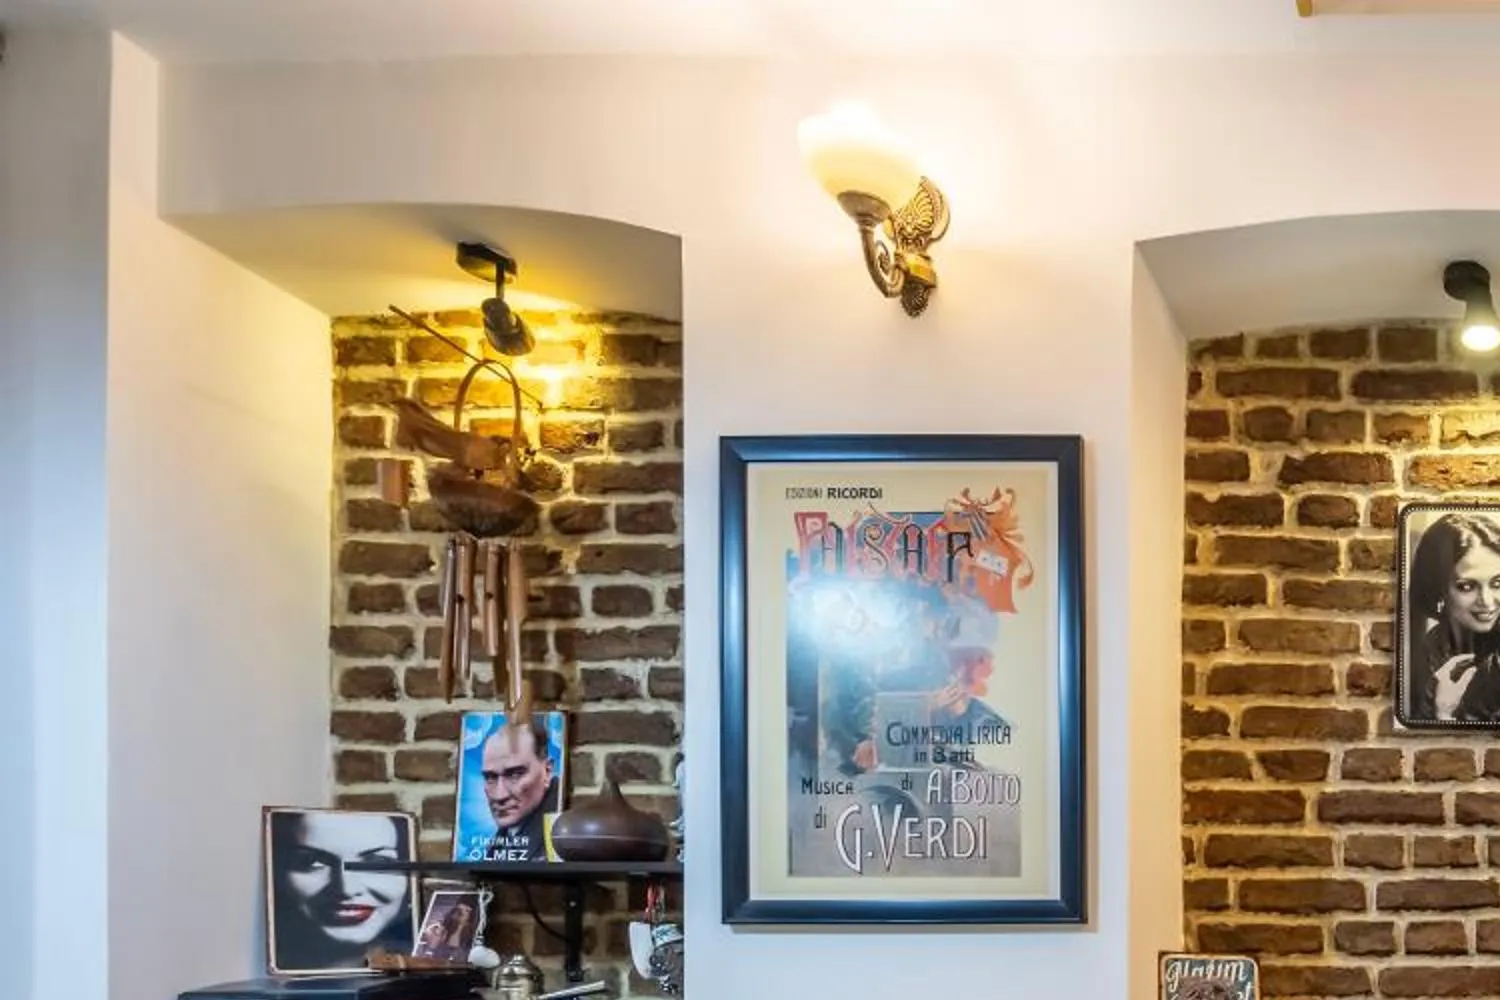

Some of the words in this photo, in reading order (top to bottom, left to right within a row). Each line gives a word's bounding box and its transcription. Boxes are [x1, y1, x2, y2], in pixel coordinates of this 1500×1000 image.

[827, 487, 883, 499] RICORDI
[886, 721, 963, 746] COMMEDIA
[966, 722, 1012, 745] LIRICA
[914, 747, 928, 763] in
[800, 777, 855, 795] MUSICA
[901, 771, 913, 791] di
[814, 806, 827, 829] di
